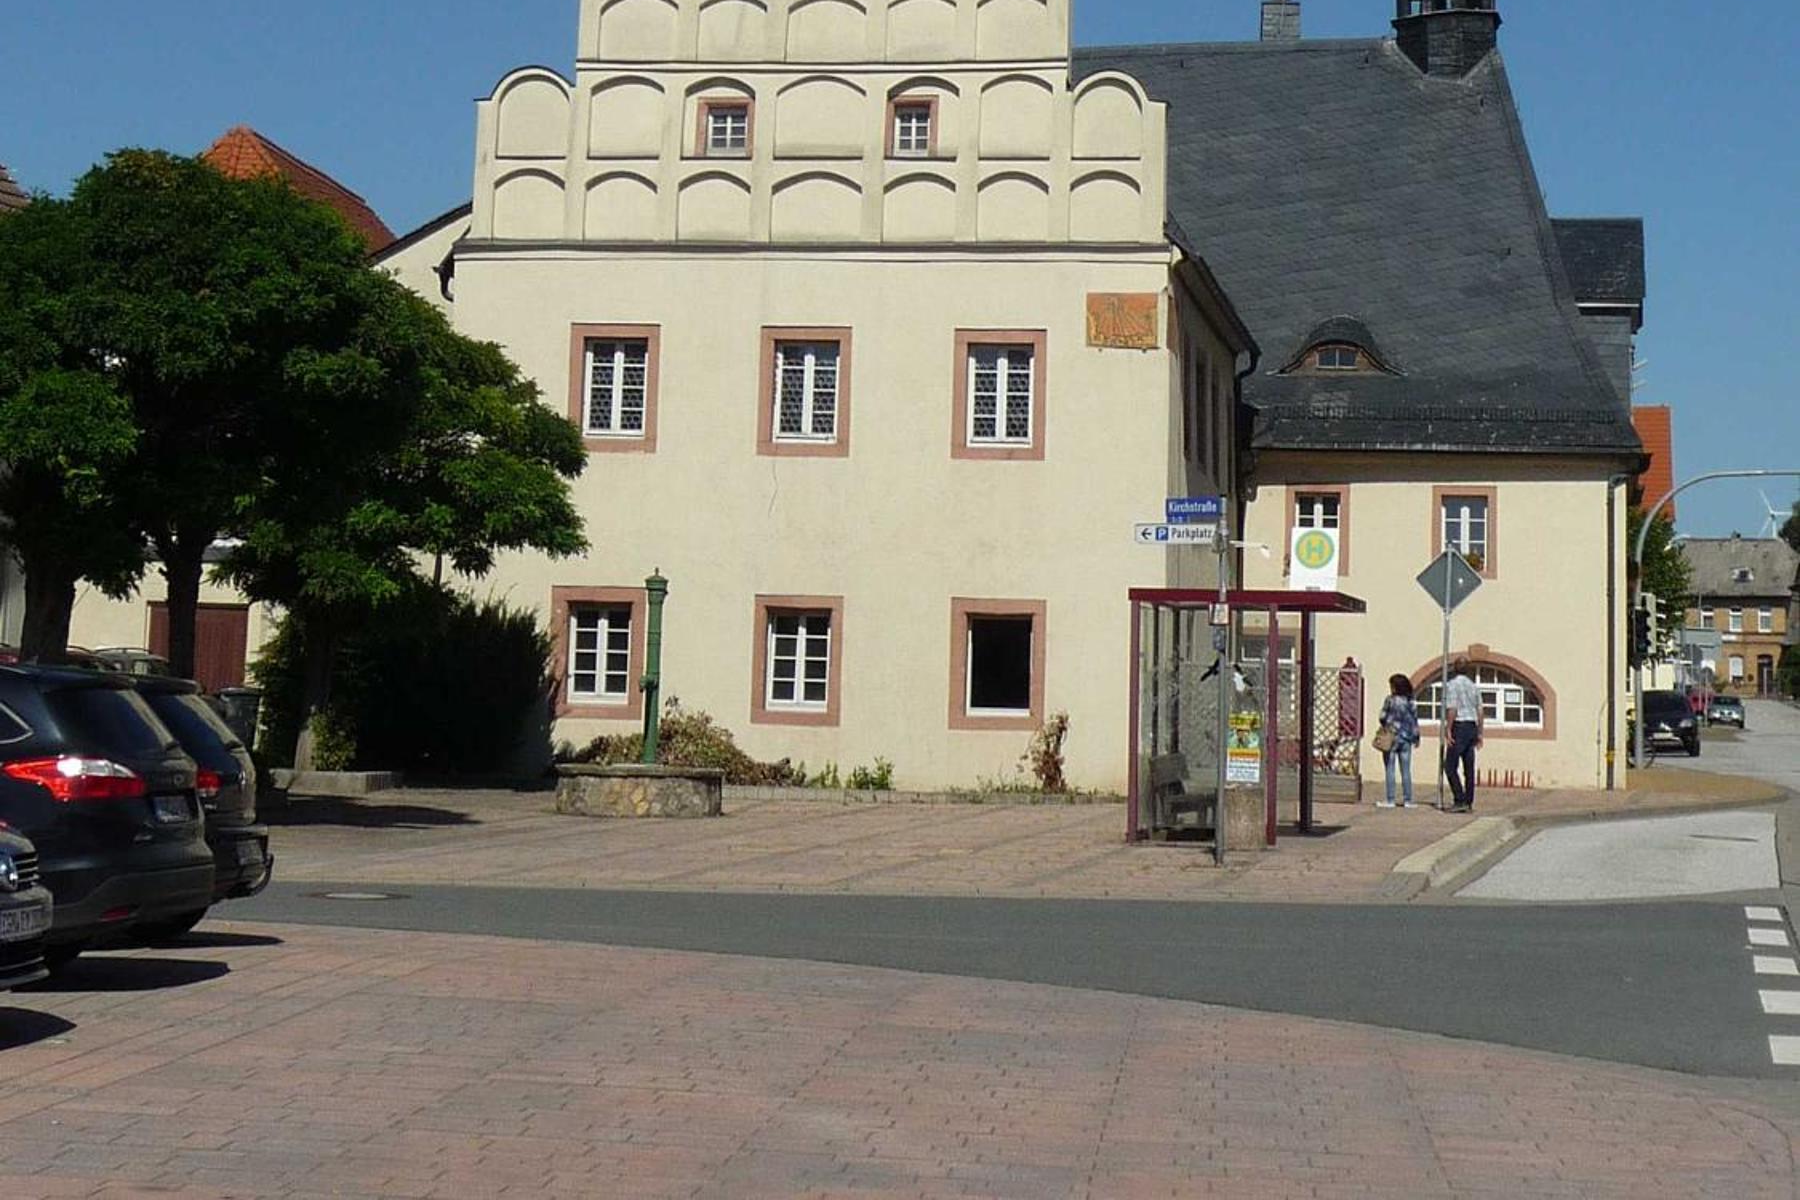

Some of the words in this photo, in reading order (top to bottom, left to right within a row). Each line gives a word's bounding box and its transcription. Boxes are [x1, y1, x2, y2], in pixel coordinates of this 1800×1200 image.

[1168, 501, 1217, 513] Kirchstraße
[1158, 529, 1167, 539] P
[1171, 527, 1213, 541] Parkplatz
[1307, 539, 1324, 560] H
